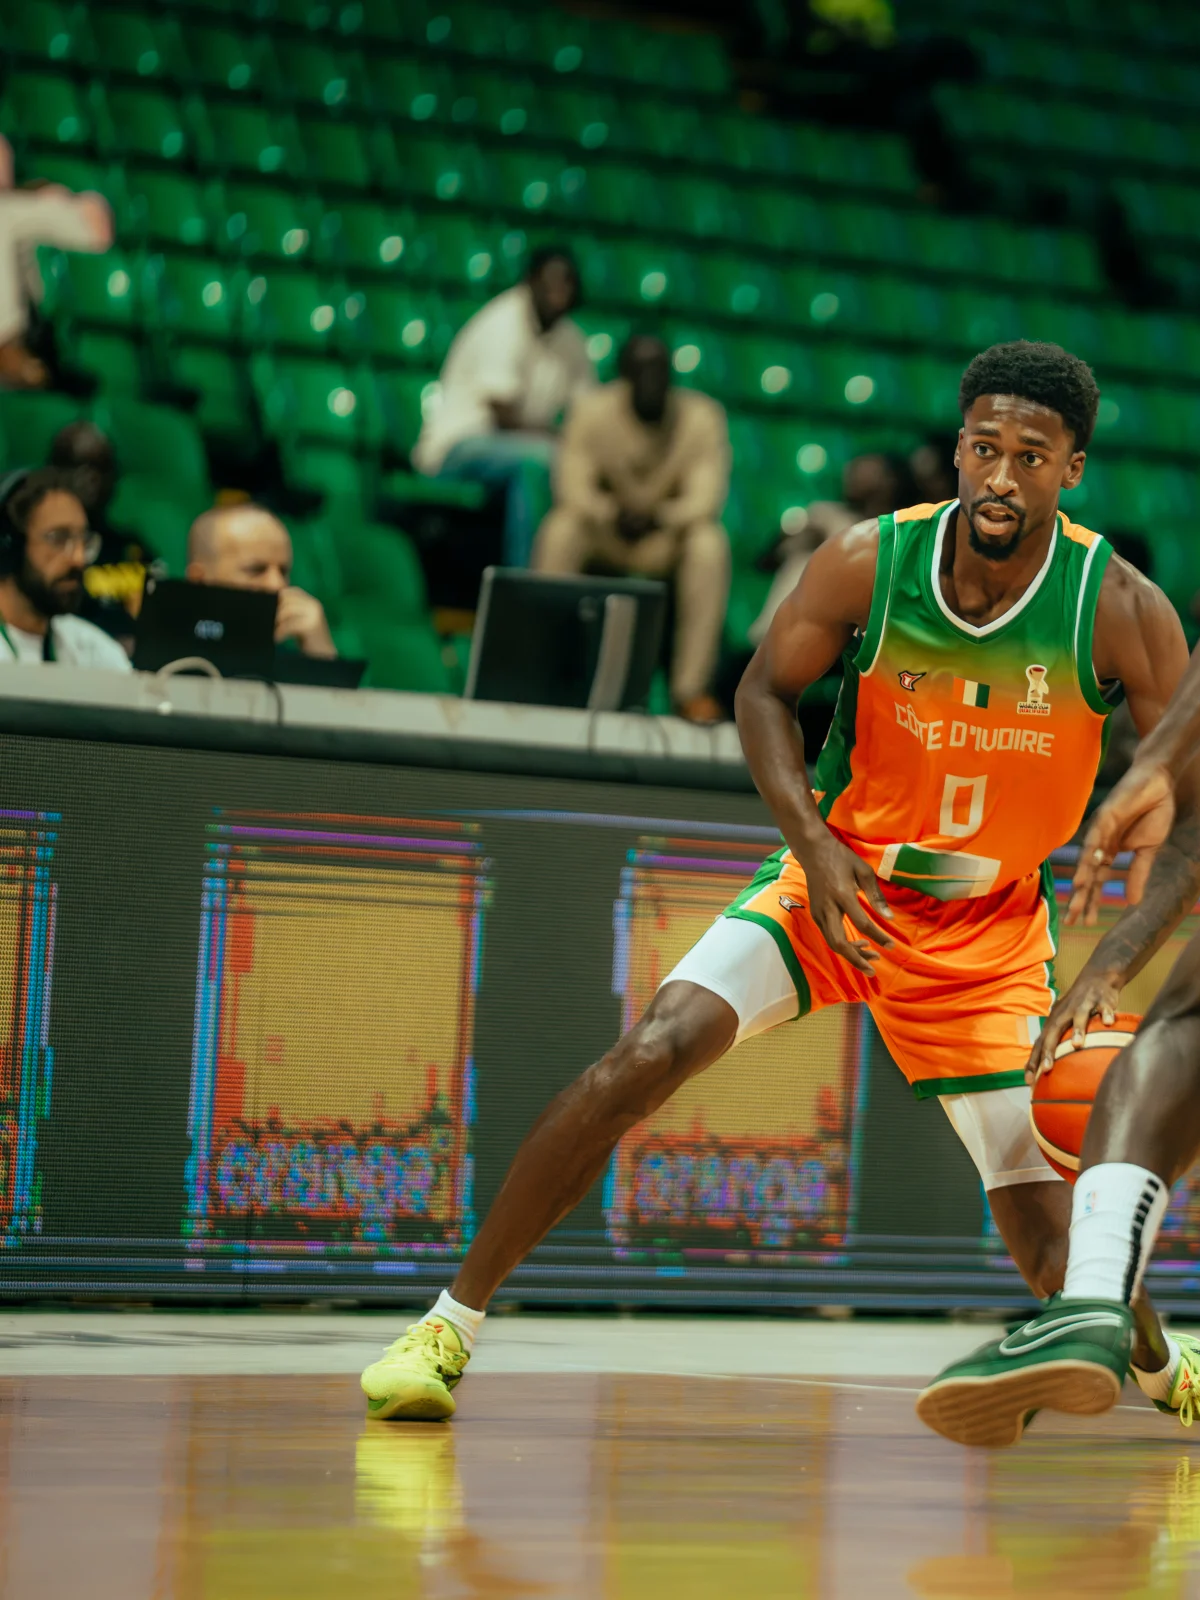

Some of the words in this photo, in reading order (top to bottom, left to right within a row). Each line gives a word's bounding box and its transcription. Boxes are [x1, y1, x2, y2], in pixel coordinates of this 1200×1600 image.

[894, 701, 943, 750] CÔTE
[949, 720, 1055, 757] D'IVOIRE
[939, 773, 988, 838] 0
